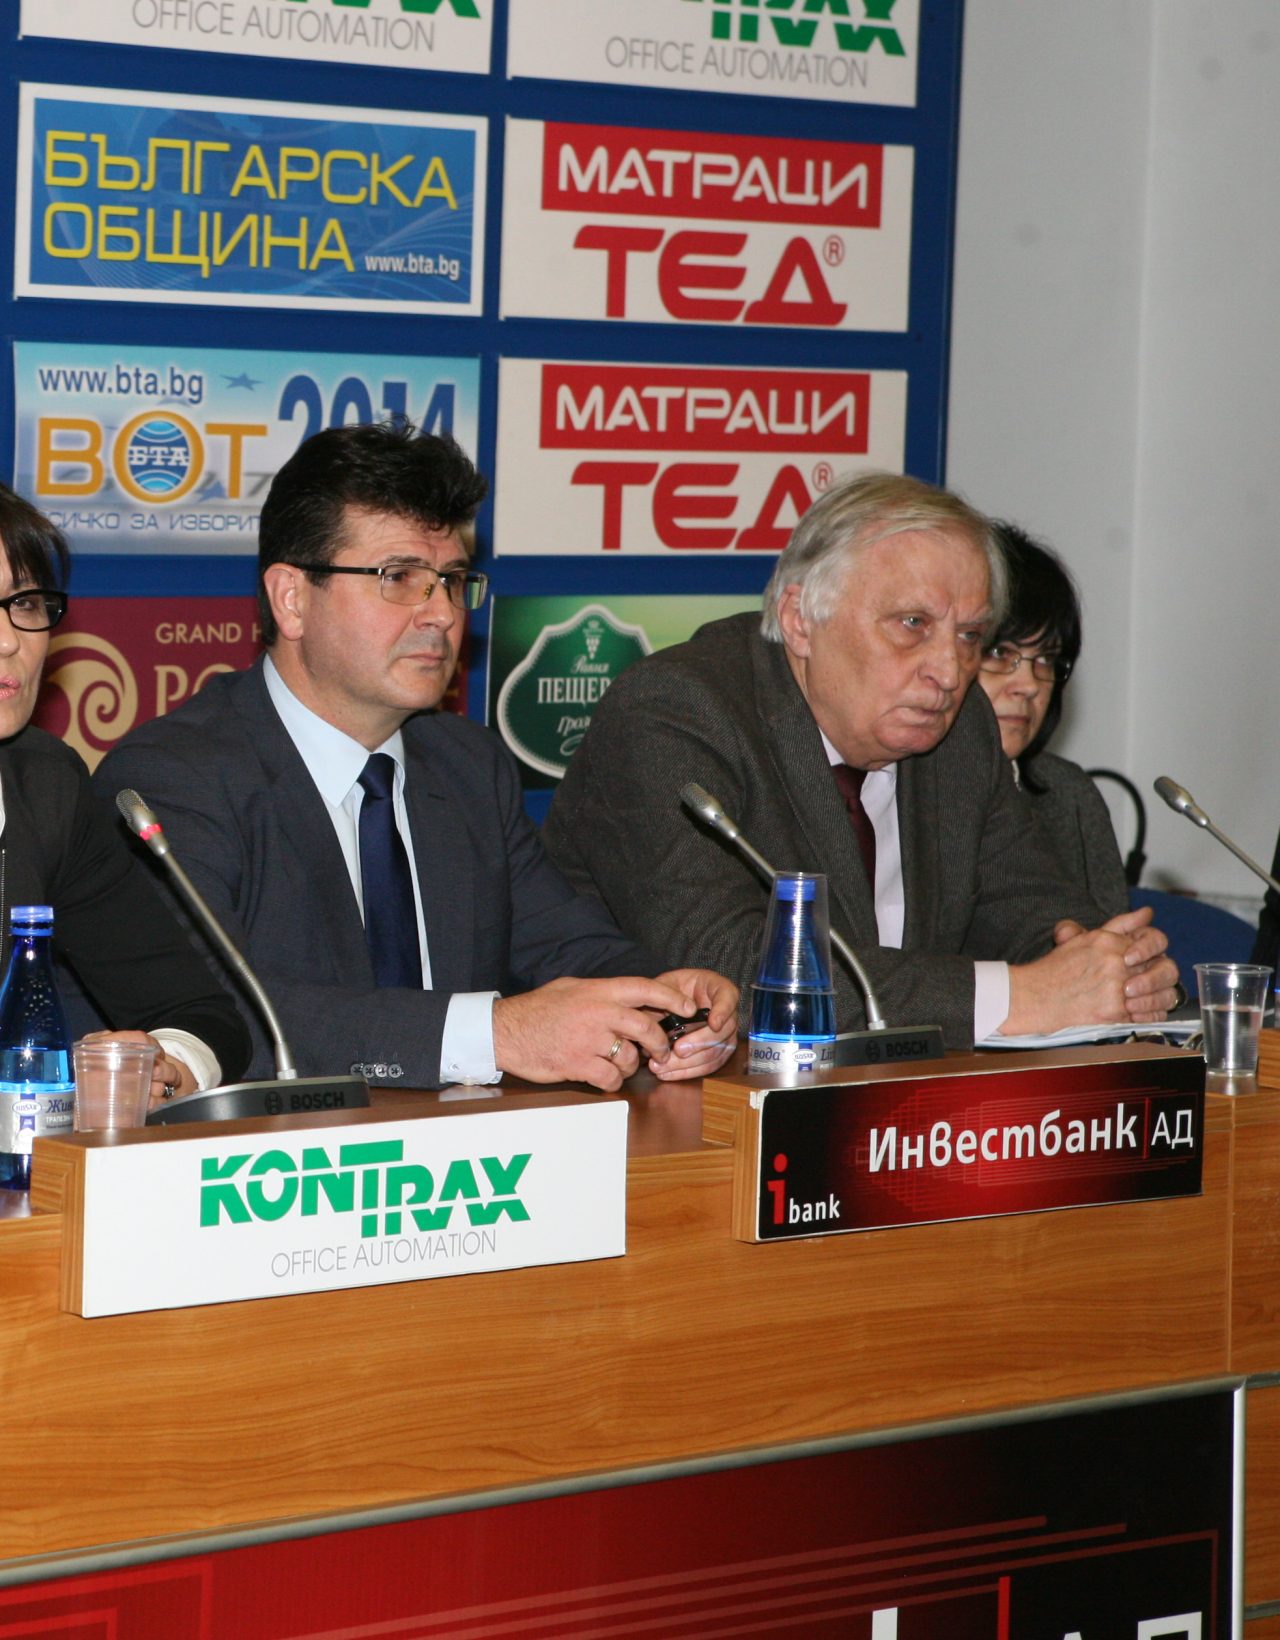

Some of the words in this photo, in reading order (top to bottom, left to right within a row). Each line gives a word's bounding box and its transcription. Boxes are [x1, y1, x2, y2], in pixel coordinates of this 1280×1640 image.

[132, 0, 234, 36] OFFICE
[242, 6, 434, 51] AUTOMATION
[605, 36, 694, 74] OFFICE
[701, 46, 868, 87] AUTOMATION
[44, 130, 458, 210] БЪЛГАРСКА
[558, 143, 868, 209] МАТРАЦИ
[43, 202, 355, 278] ОБЩИНА
[364, 253, 460, 281] www.bta.bg
[38, 364, 204, 403] www.bta.bg
[556, 384, 856, 437] МАТРАЦИ
[35, 410, 268, 505] ВОТ
[127, 444, 190, 467] БТА
[47, 511, 119, 529] СИЧКО
[130, 513, 159, 530] ЗА
[155, 622, 242, 644] GRAND
[885, 1040, 929, 1058] BOSCH
[290, 1091, 345, 1110] BOSCH
[868, 1102, 1138, 1173] Инвестбанк
[1150, 1109, 1194, 1149] АД
[199, 1139, 533, 1239] KONTRAX
[271, 1247, 347, 1278] OFFICE
[353, 1231, 496, 1269] AUTOMATION
